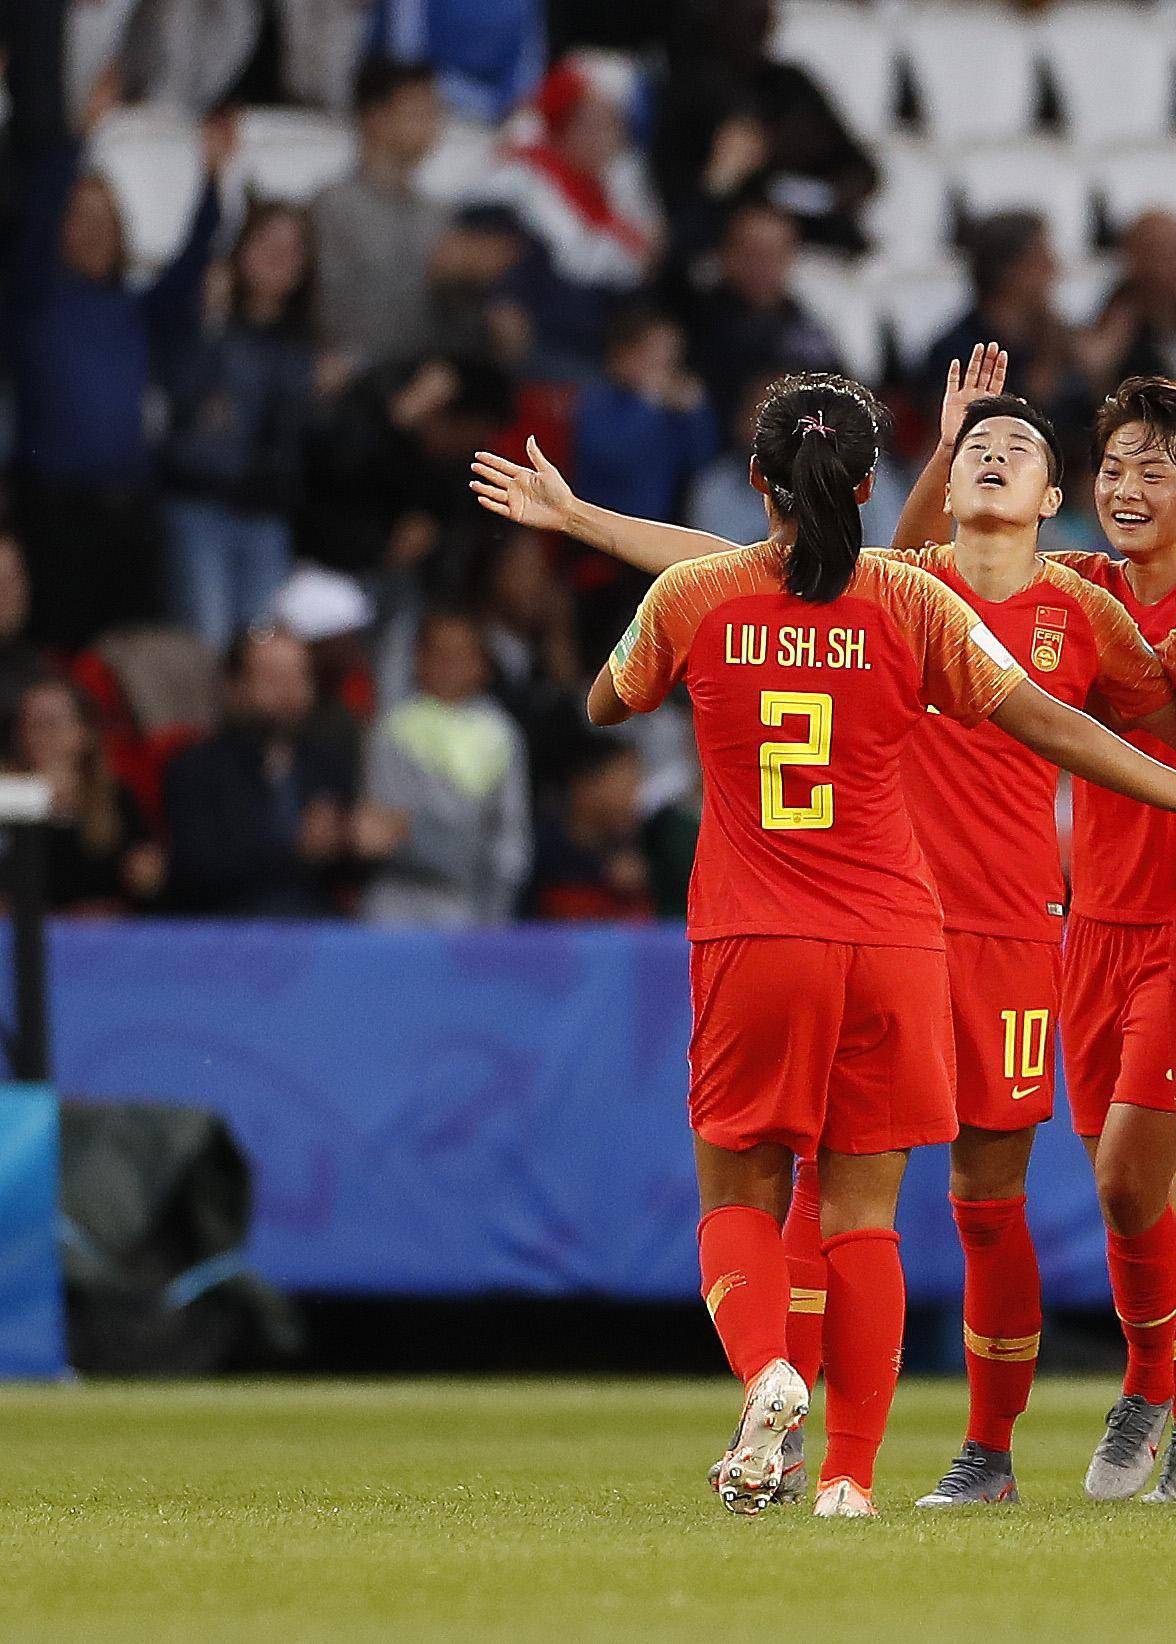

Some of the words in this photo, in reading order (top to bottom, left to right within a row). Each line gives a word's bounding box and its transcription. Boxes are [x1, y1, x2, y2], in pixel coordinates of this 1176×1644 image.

[725, 623, 768, 665] LIU
[1037, 630, 1061, 643] CFA
[759, 690, 834, 830] 2
[1000, 1009, 1049, 1078] 10
